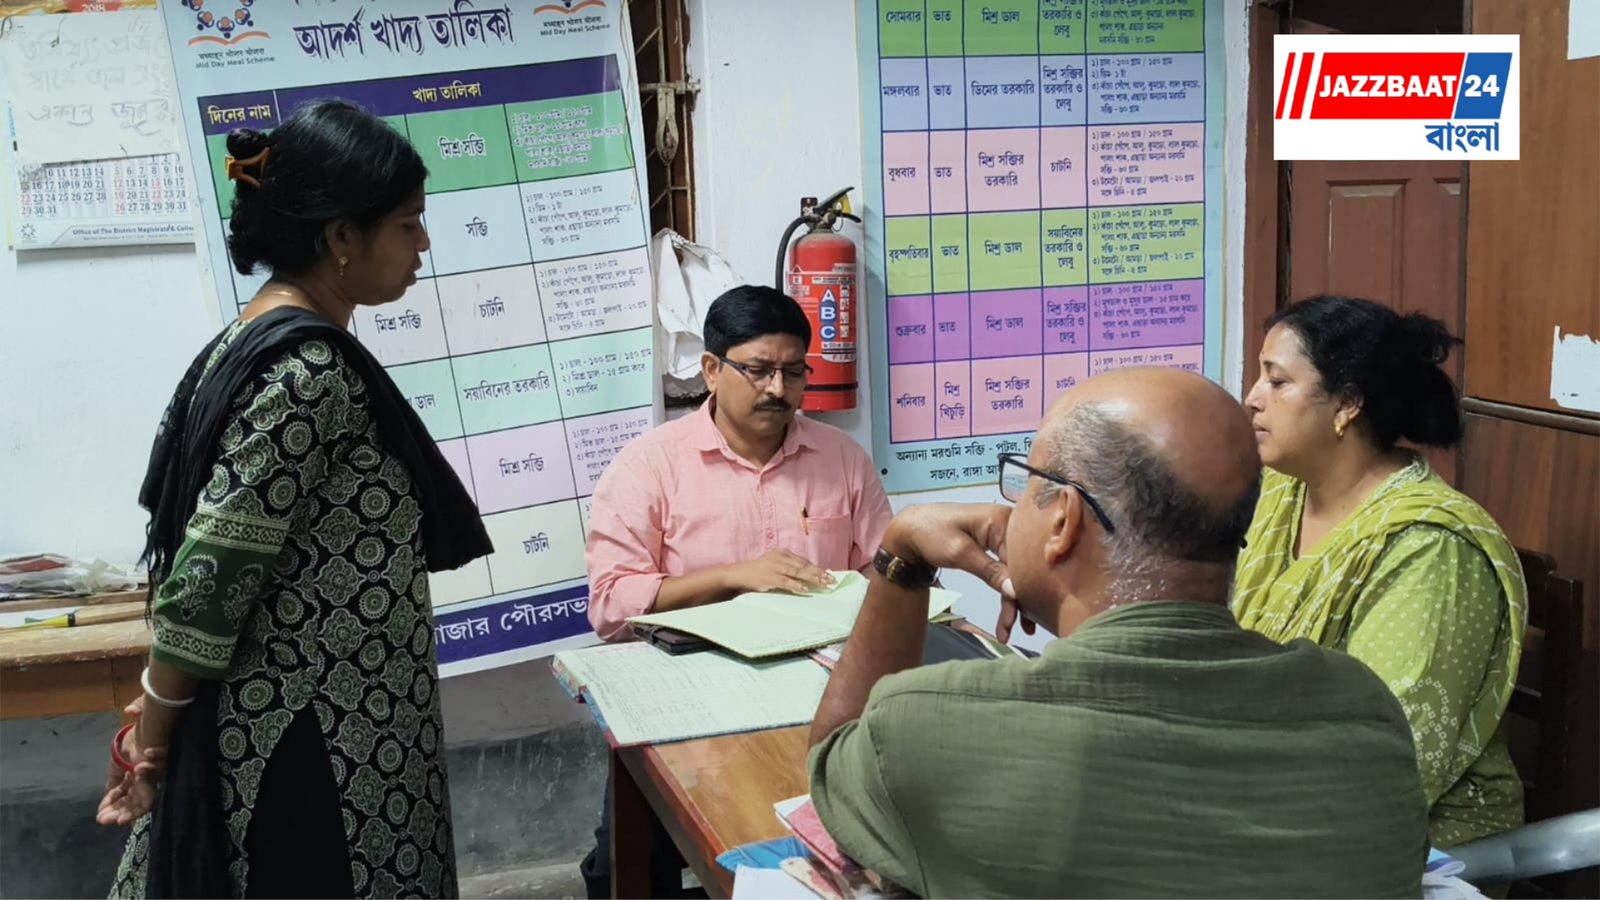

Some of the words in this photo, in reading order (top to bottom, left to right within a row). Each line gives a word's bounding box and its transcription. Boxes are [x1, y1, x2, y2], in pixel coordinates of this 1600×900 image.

[886, 10, 921, 23] সোমবার
[933, 10, 951, 22] ভাত
[981, 7, 998, 24] মিশ্র
[1001, 10, 1020, 22] ডাল
[1042, 6, 1072, 21] তরকারি
[1076, 10, 1082, 20] ও
[293, 6, 365, 60] আদর্শ
[371, 13, 424, 55] খাদ্য
[425, 0, 513, 47] তালিকা
[554, 28, 566, 36] Day
[1053, 25, 1071, 38] লেবু
[211, 61, 225, 69] Day
[227, 58, 245, 66] Meal
[246, 56, 275, 65] Scheme
[1043, 65, 1057, 81] মিশ্র
[412, 87, 437, 103] খাদ্য
[439, 80, 481, 100] তালিকা
[933, 84, 952, 96] ভাত
[970, 81, 998, 97] ডিমের
[1000, 79, 1035, 95] তরকারি
[1043, 79, 1073, 94] তরকারি
[1076, 83, 1083, 93] ও
[1055, 98, 1072, 112] লেবু
[207, 104, 245, 125] দিনের
[248, 103, 272, 120] নাম
[439, 137, 462, 159] মিশ্র
[978, 151, 994, 168] মিশ্র
[1050, 158, 1072, 173] চাটনি
[888, 166, 916, 181] বুধবার
[934, 166, 952, 178] ভাত
[984, 171, 1018, 187] তরকারি
[101, 227, 112, 235] The
[113, 226, 136, 234] District
[941, 245, 960, 257] ভাত
[984, 240, 1001, 256] মিশ্র
[1004, 241, 1022, 253] ডাল
[1044, 239, 1073, 254] তরকারি
[1077, 242, 1083, 252] ও
[1057, 256, 1075, 270] লেবু
[478, 297, 505, 319] চাটনি
[1047, 301, 1062, 315] মিশ্র
[374, 313, 397, 334] মিশ্র
[938, 321, 956, 333] ভাত
[986, 315, 1002, 331] মিশ্র
[1005, 317, 1024, 330] ডাল
[1046, 314, 1075, 328] তরকারি
[1078, 317, 1085, 327] ও
[1059, 331, 1076, 344] লেবু
[513, 371, 551, 394] তরকারি
[944, 381, 960, 397] মিশ্র
[985, 378, 1002, 394] মিশ্র
[415, 393, 436, 410] ডাল
[896, 393, 926, 408] শনিবার
[991, 395, 1024, 411] তরকারি
[499, 457, 521, 479] মিশ্র
[522, 532, 550, 555] চাটনি
[500, 596, 590, 631] পৌরসভ
